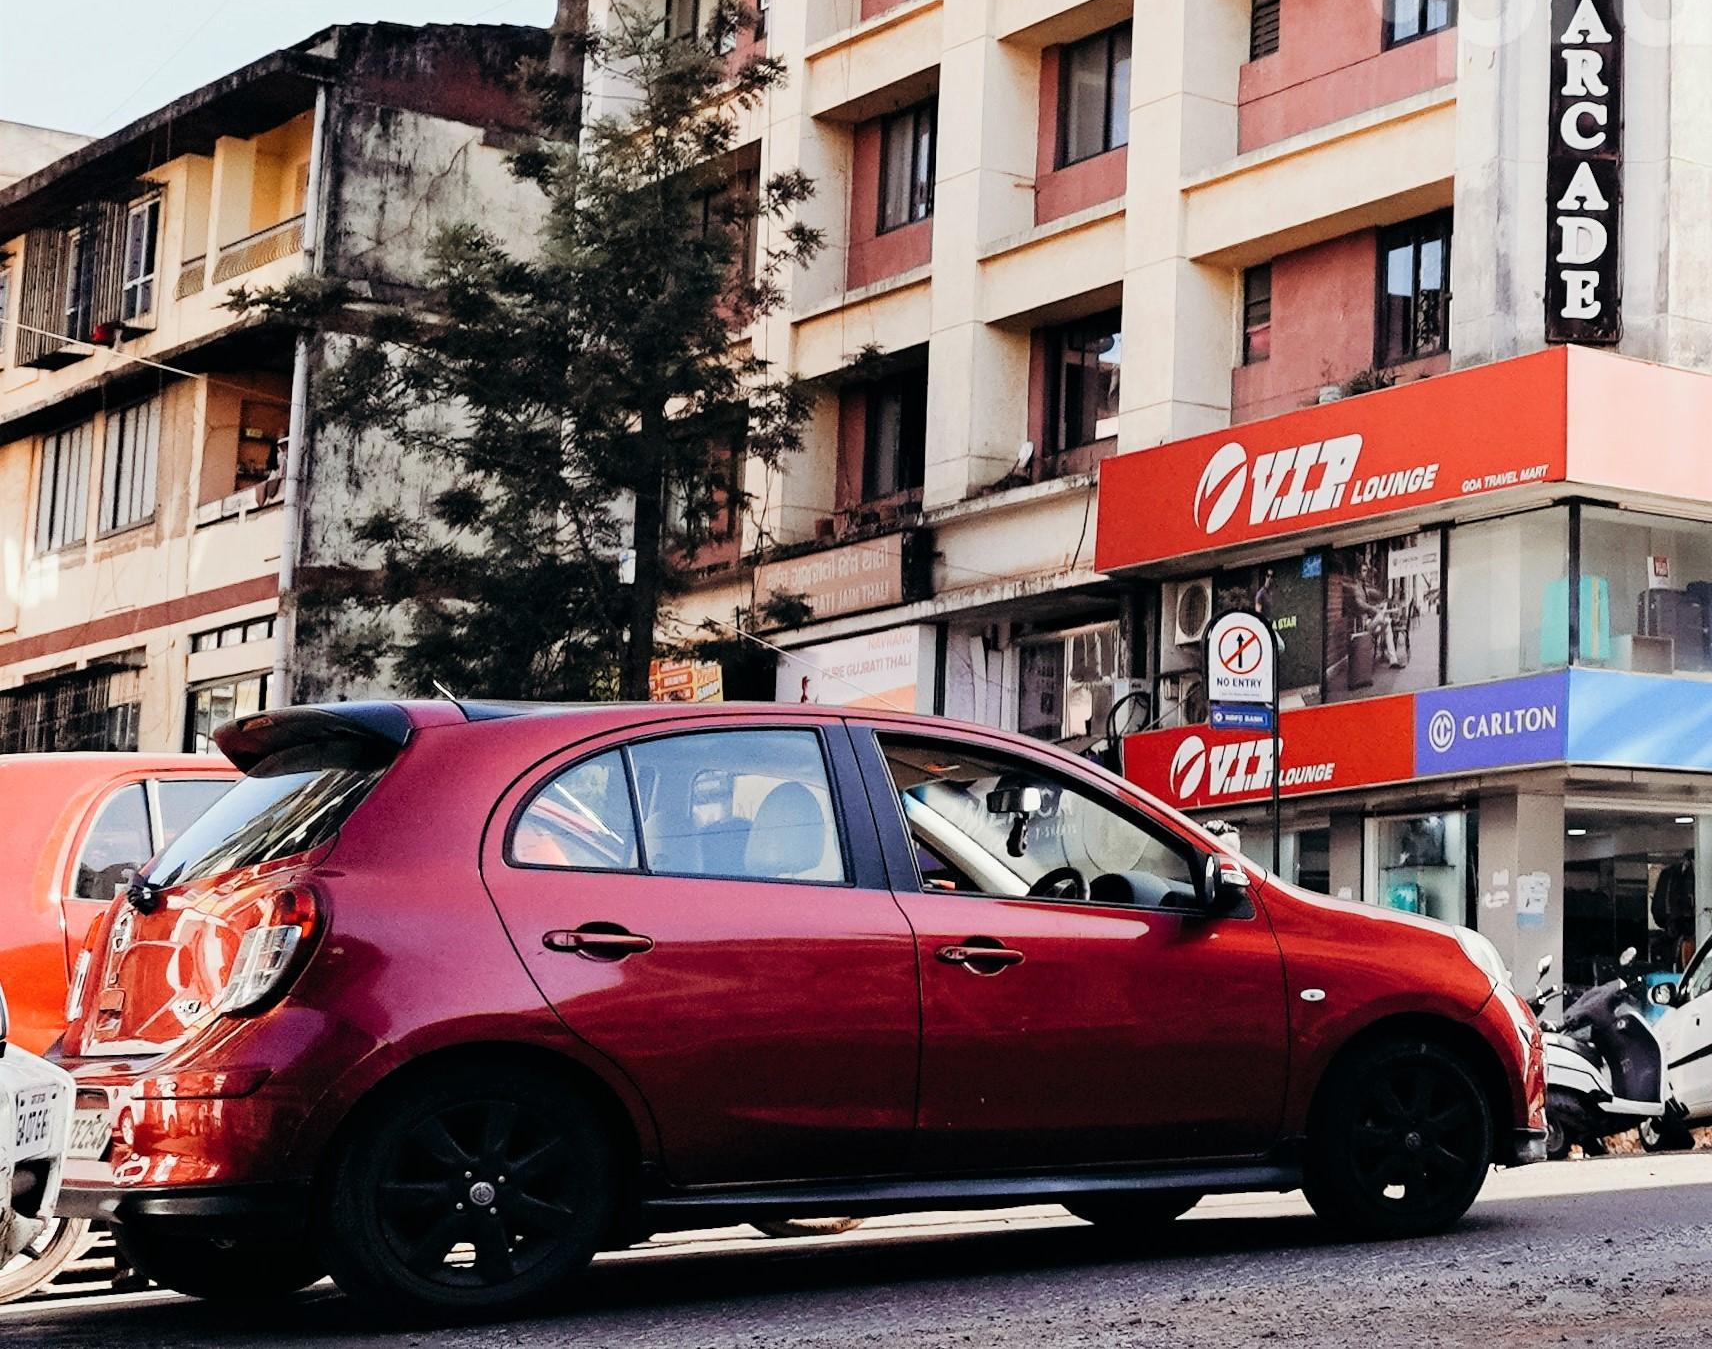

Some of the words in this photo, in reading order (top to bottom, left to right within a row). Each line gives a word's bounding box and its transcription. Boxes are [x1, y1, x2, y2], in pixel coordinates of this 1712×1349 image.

[1250, 434, 1363, 525] VIP
[1352, 463, 1440, 506] LOUNGE
[1461, 478, 1482, 494] GOA
[1484, 472, 1519, 489] TRAVEL
[1520, 464, 1550, 483] MART
[886, 654, 912, 669] THALI
[1216, 677, 1230, 688] NO
[1232, 677, 1262, 688] ENTRY
[1461, 705, 1557, 739] CARLTON
[1209, 737, 1284, 796] VIP
